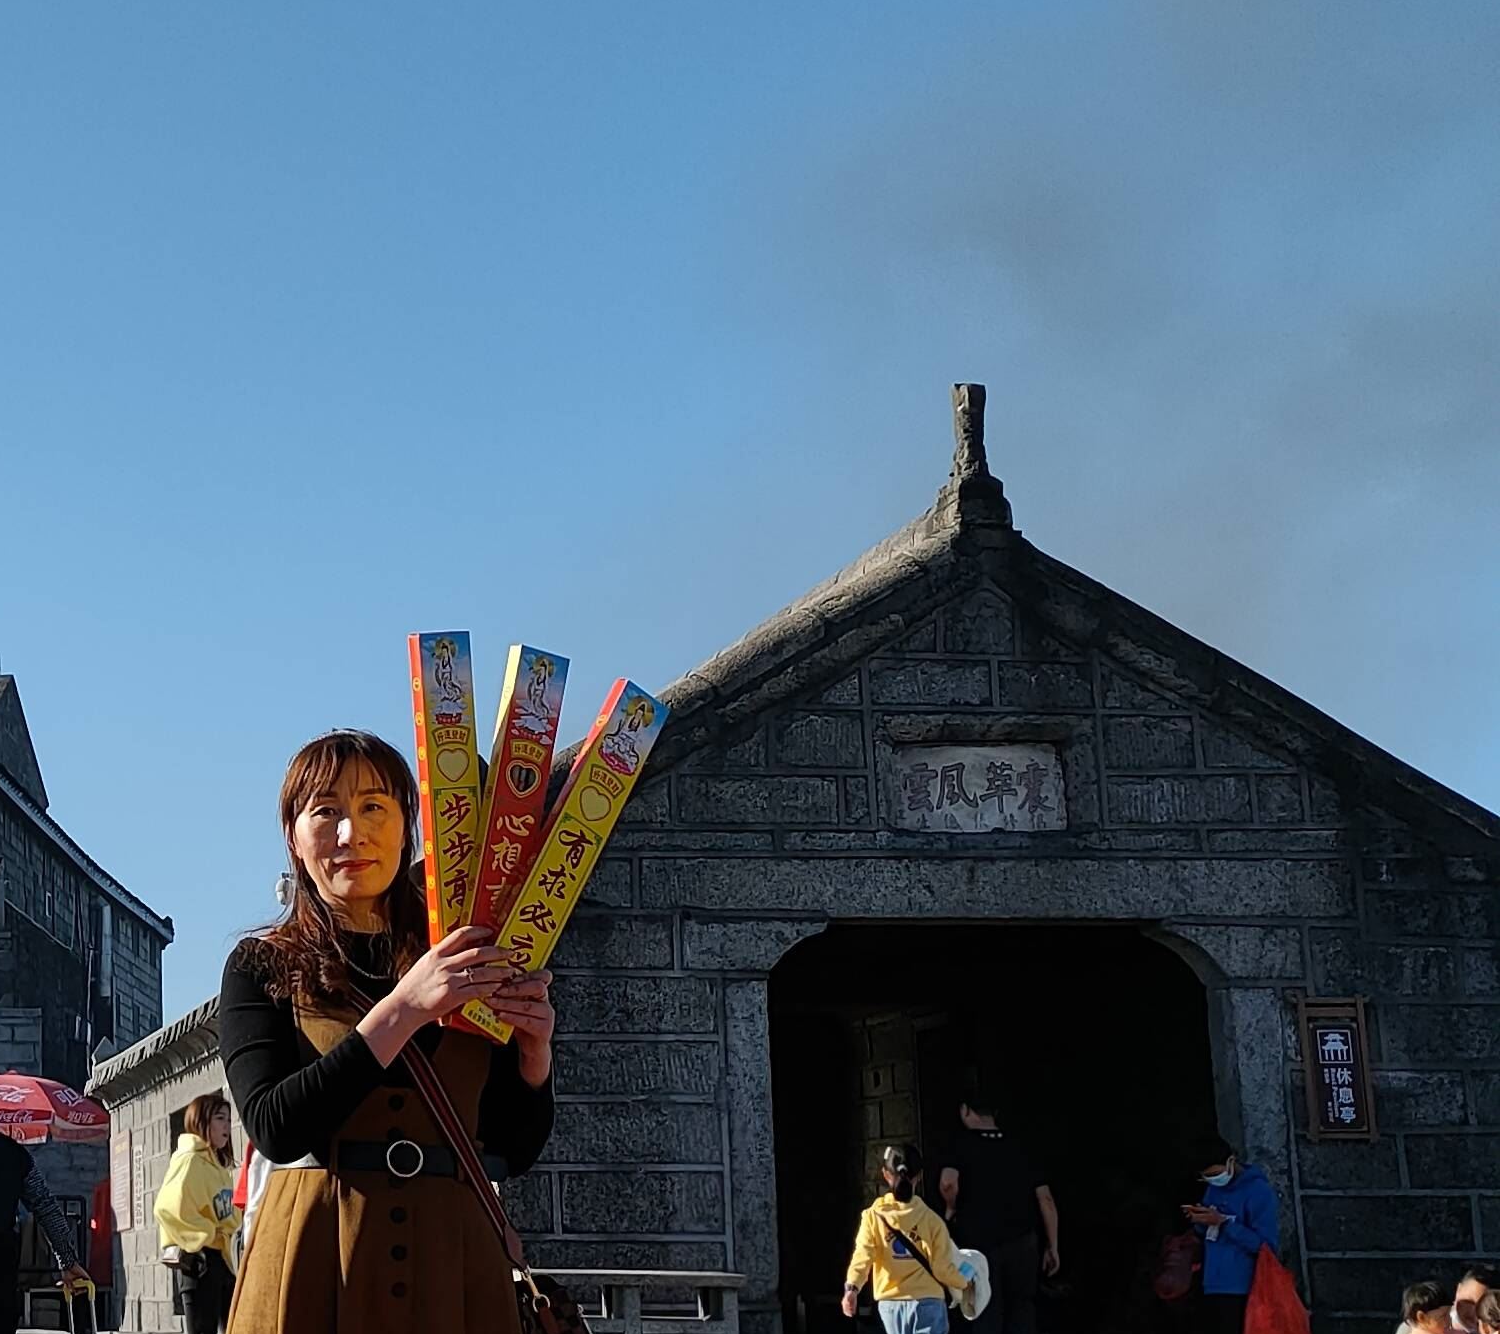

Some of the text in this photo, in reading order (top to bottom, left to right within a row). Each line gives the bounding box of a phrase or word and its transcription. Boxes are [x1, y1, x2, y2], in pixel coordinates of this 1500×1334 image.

[440, 793, 474, 932] 步步高
[1336, 1067, 1356, 1124] 休息亭
